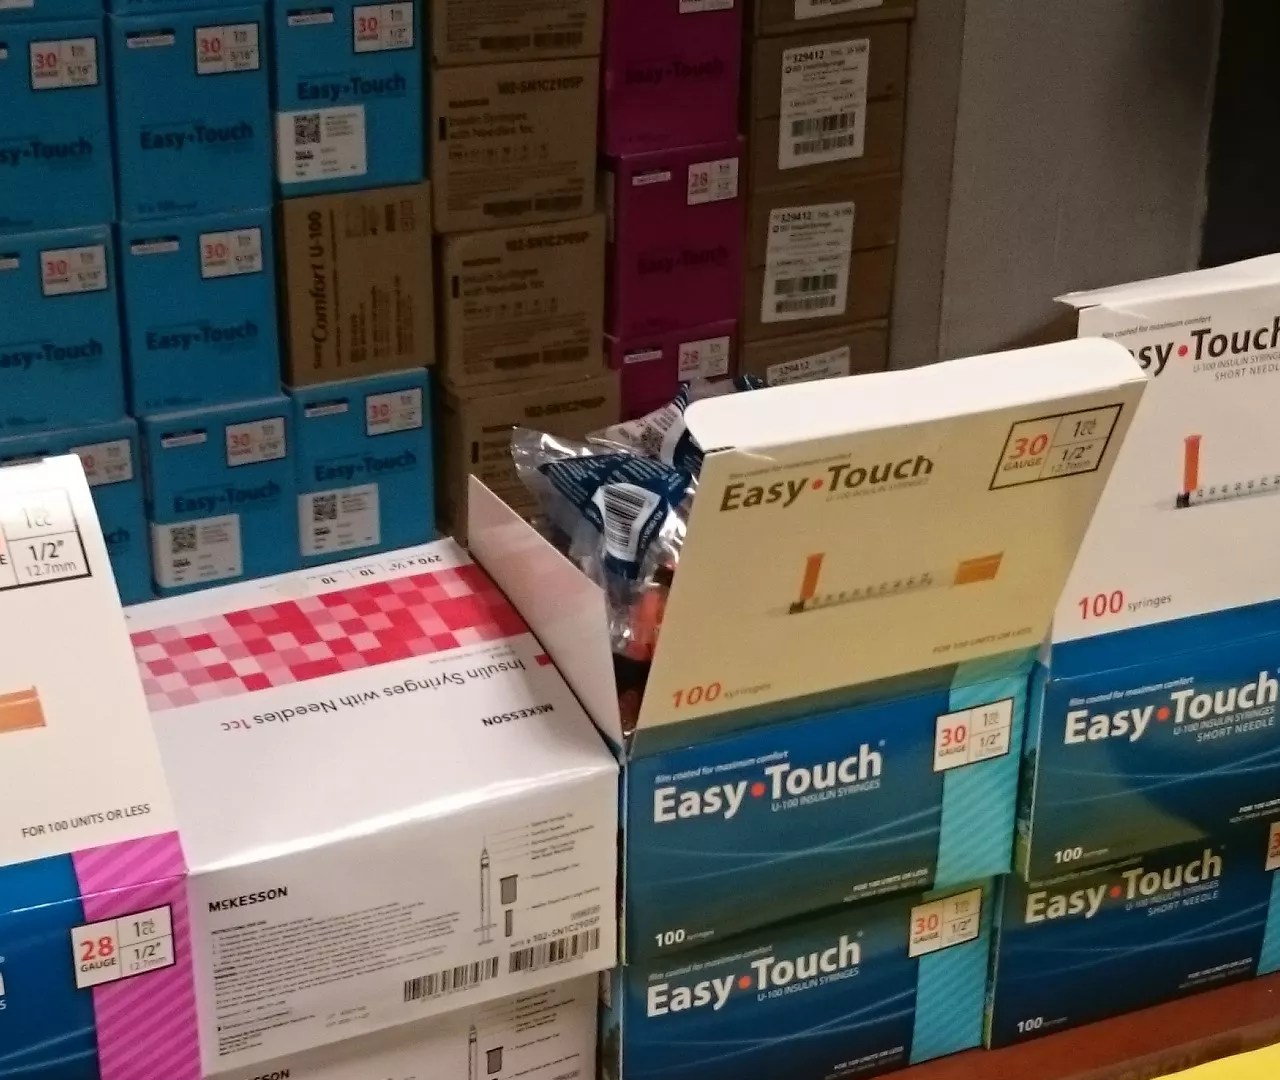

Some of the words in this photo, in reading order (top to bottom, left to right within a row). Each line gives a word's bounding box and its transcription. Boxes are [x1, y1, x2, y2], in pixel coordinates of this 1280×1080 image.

[1008, 433, 1050, 459] 30
[1077, 590, 1123, 620] 100
[466, 659, 528, 683] Insulin
[382, 668, 466, 704] Syringes
[672, 681, 723, 710] 100
[252, 698, 338, 728] Needles
[339, 687, 381, 713] with
[939, 724, 967, 747] 30
[1196, 727, 1234, 744] SHORT
[1235, 717, 1276, 736] NEEDLE
[124, 803, 152, 818] LESS
[914, 913, 939, 934] 30
[79, 934, 115, 962] 28
[80, 956, 118, 973] GAUGE
